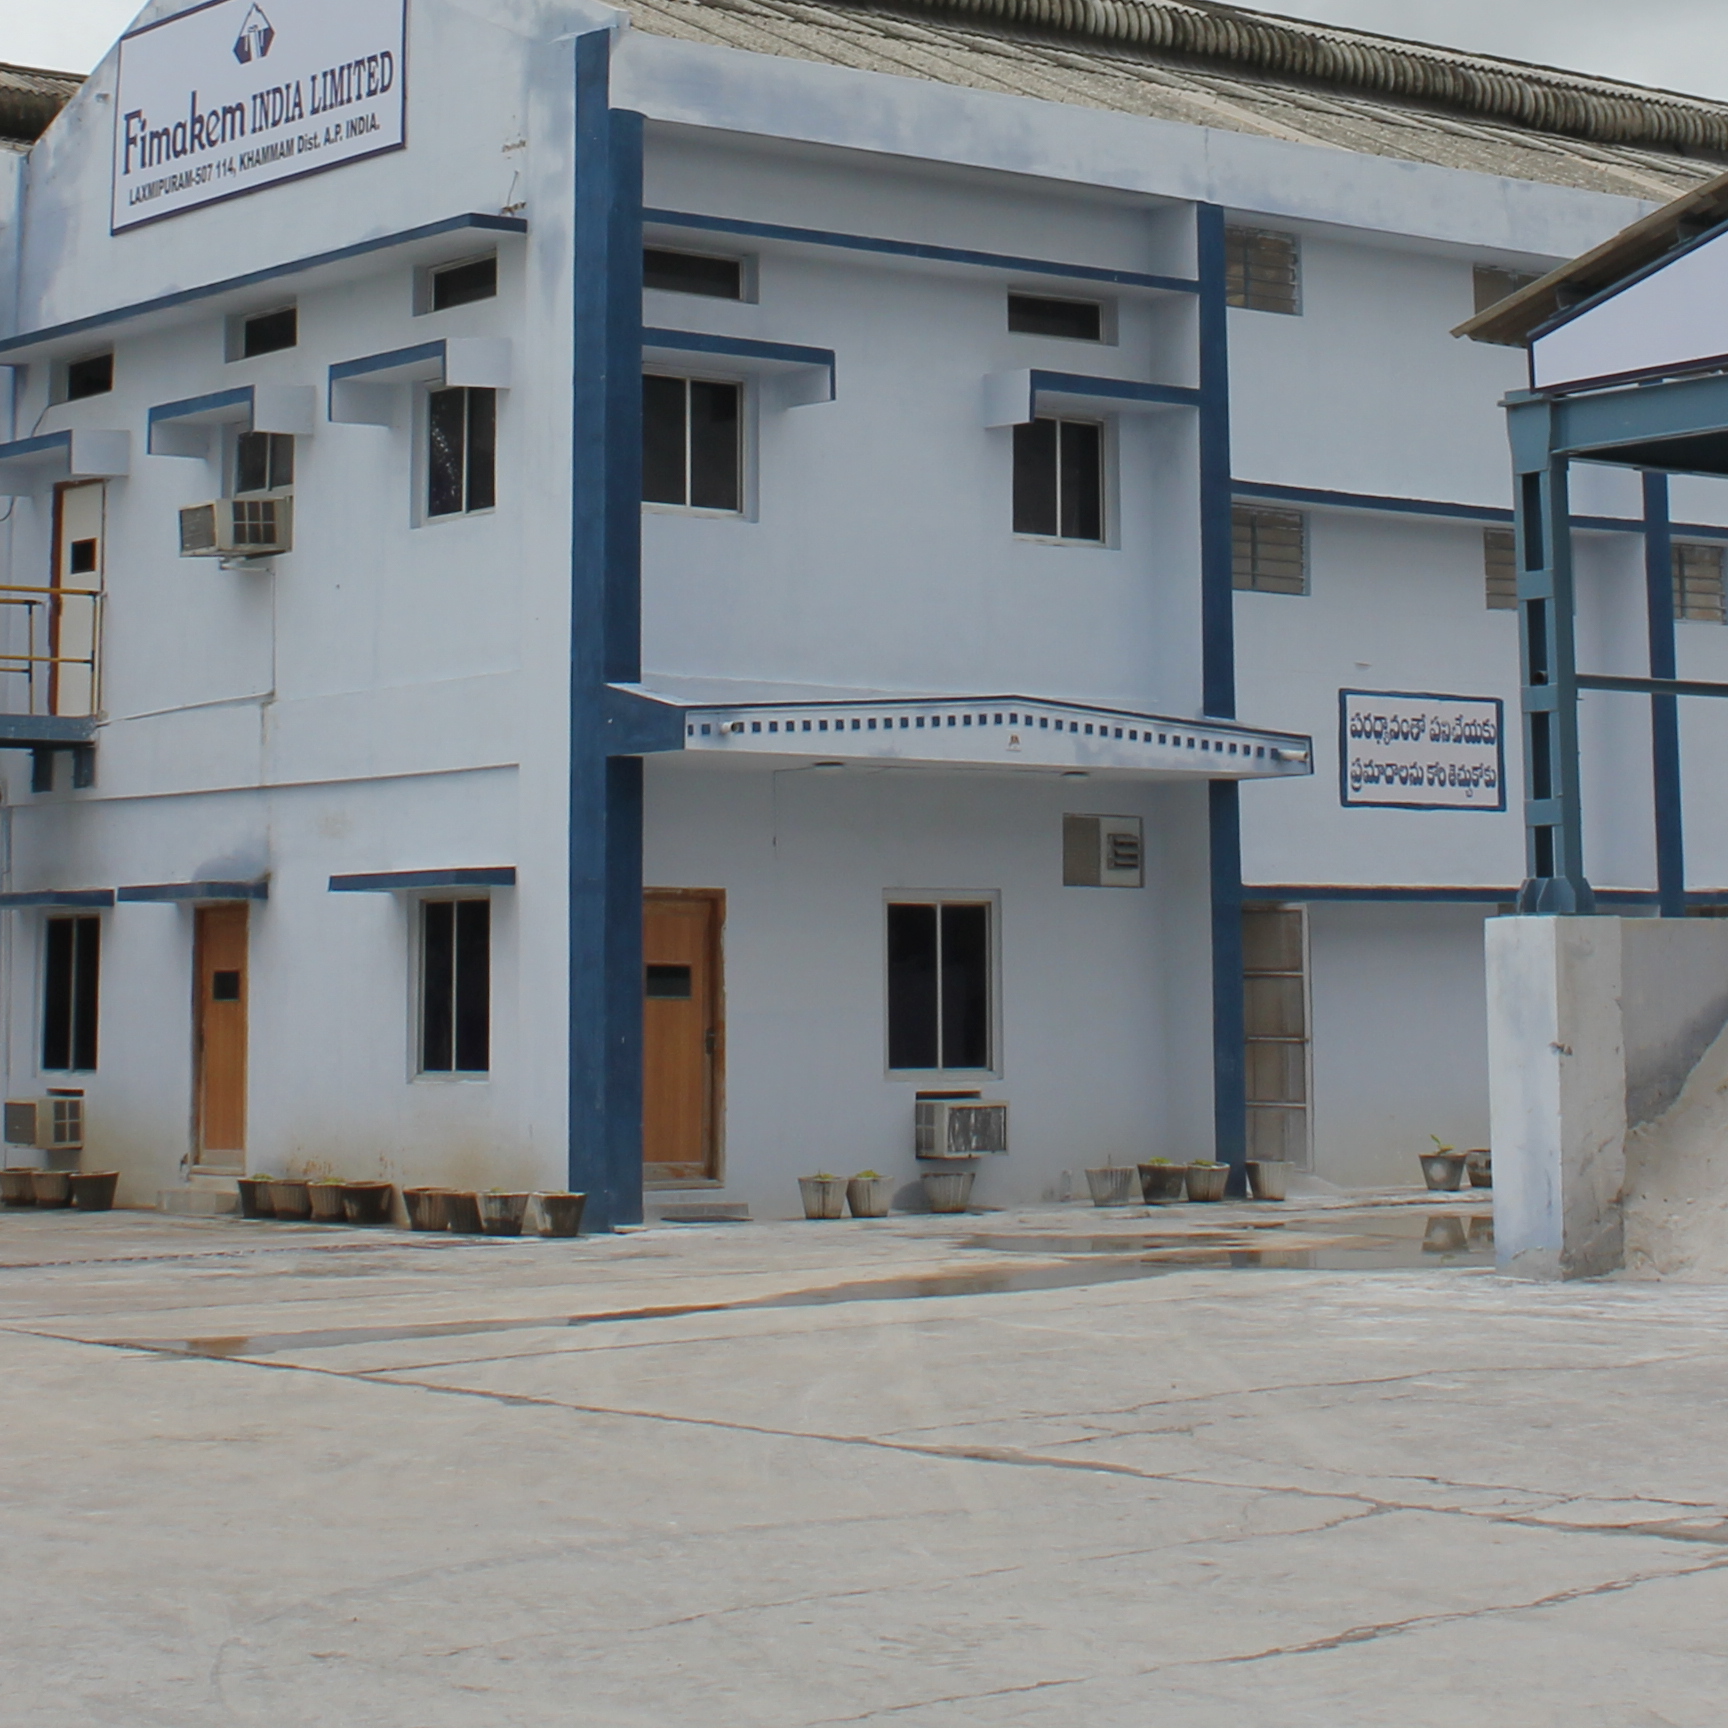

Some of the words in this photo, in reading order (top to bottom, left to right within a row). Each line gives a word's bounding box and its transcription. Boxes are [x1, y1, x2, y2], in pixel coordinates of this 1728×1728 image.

[123, 90, 245, 176] Fimakem
[251, 80, 304, 134] INDIA
[310, 50, 393, 116] LIMITED
[239, 138, 294, 172] KHAMMAM
[297, 131, 321, 154] Dist.
[346, 112, 380, 139] INDIA.
